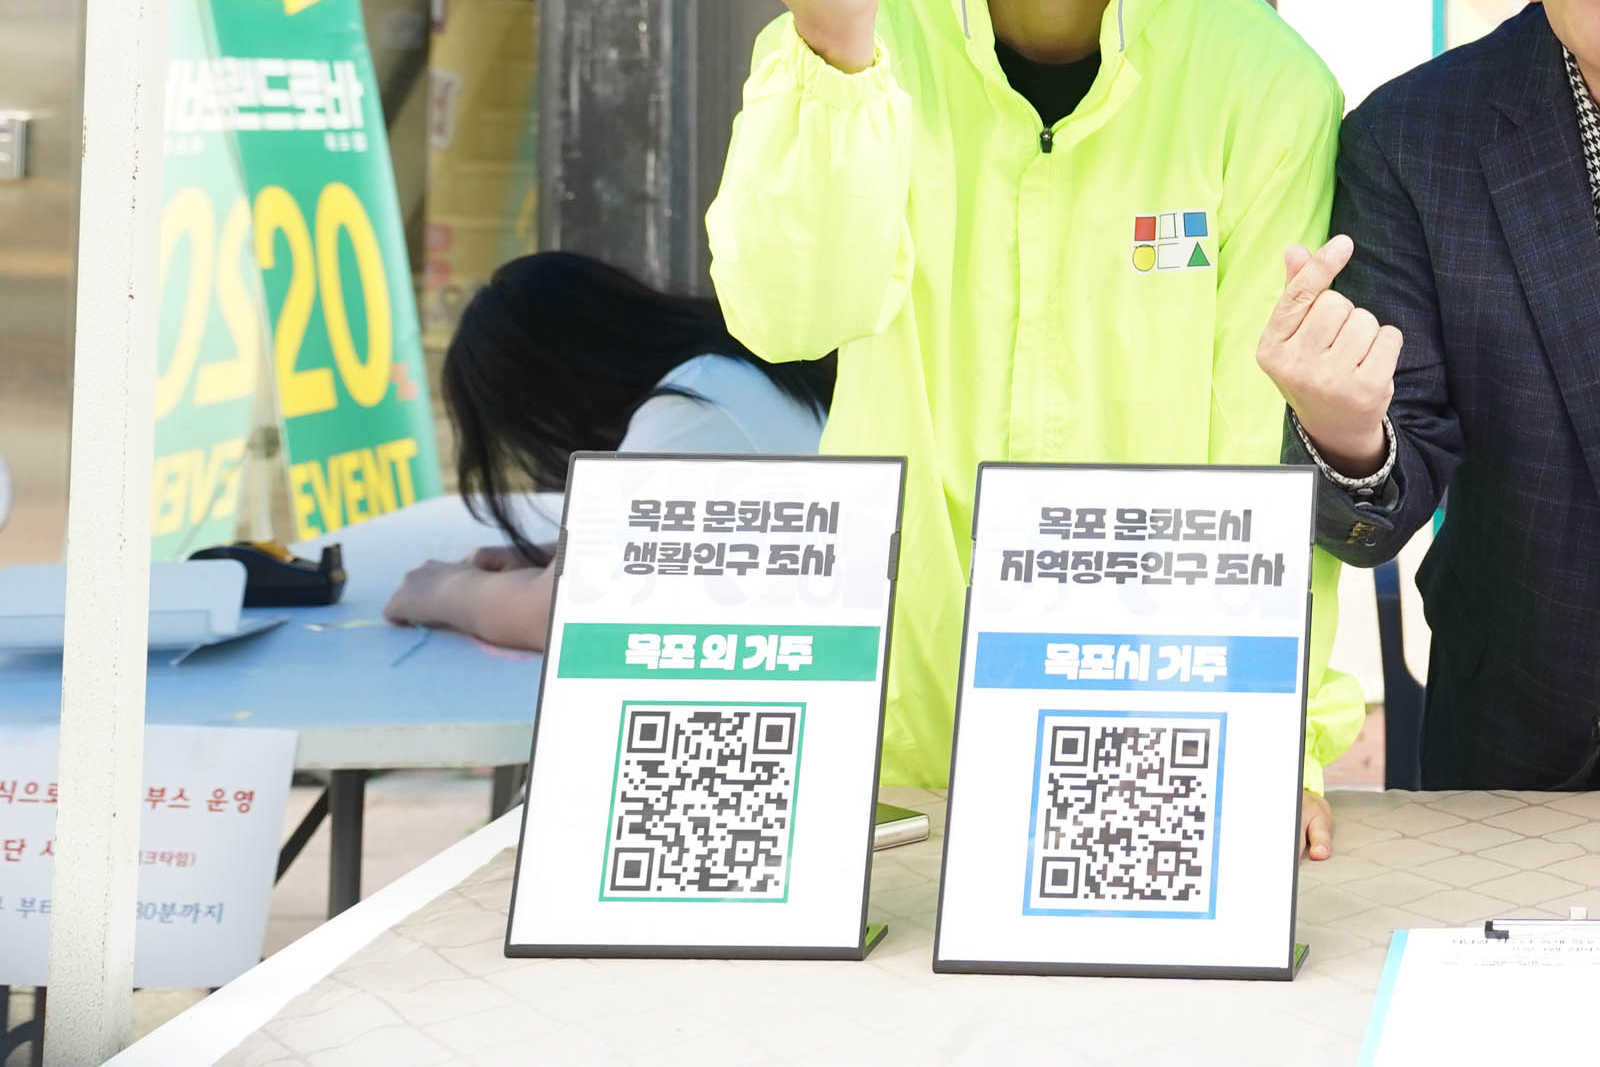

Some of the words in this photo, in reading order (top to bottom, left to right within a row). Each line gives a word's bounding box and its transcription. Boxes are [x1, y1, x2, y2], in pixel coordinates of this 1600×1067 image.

[289, 437, 418, 541] EVENT
[628, 499, 697, 532] 목포
[702, 500, 840, 534] 문화도시
[1038, 507, 1107, 540] 목포
[1114, 507, 1253, 542] 문화도시
[623, 541, 760, 576] 생활인구
[765, 543, 836, 577] 조사
[1000, 549, 1208, 585] 지역정주인구
[1214, 553, 1286, 587] 조사
[625, 633, 697, 670] 목포
[699, 634, 738, 671] 외
[742, 634, 814, 671] 거주
[1044, 642, 1151, 682] 목포시
[1156, 644, 1228, 683] 거주
[144, 786, 191, 810] 부스
[205, 787, 256, 814] 운영
[139, 850, 197, 868] 크타임)
